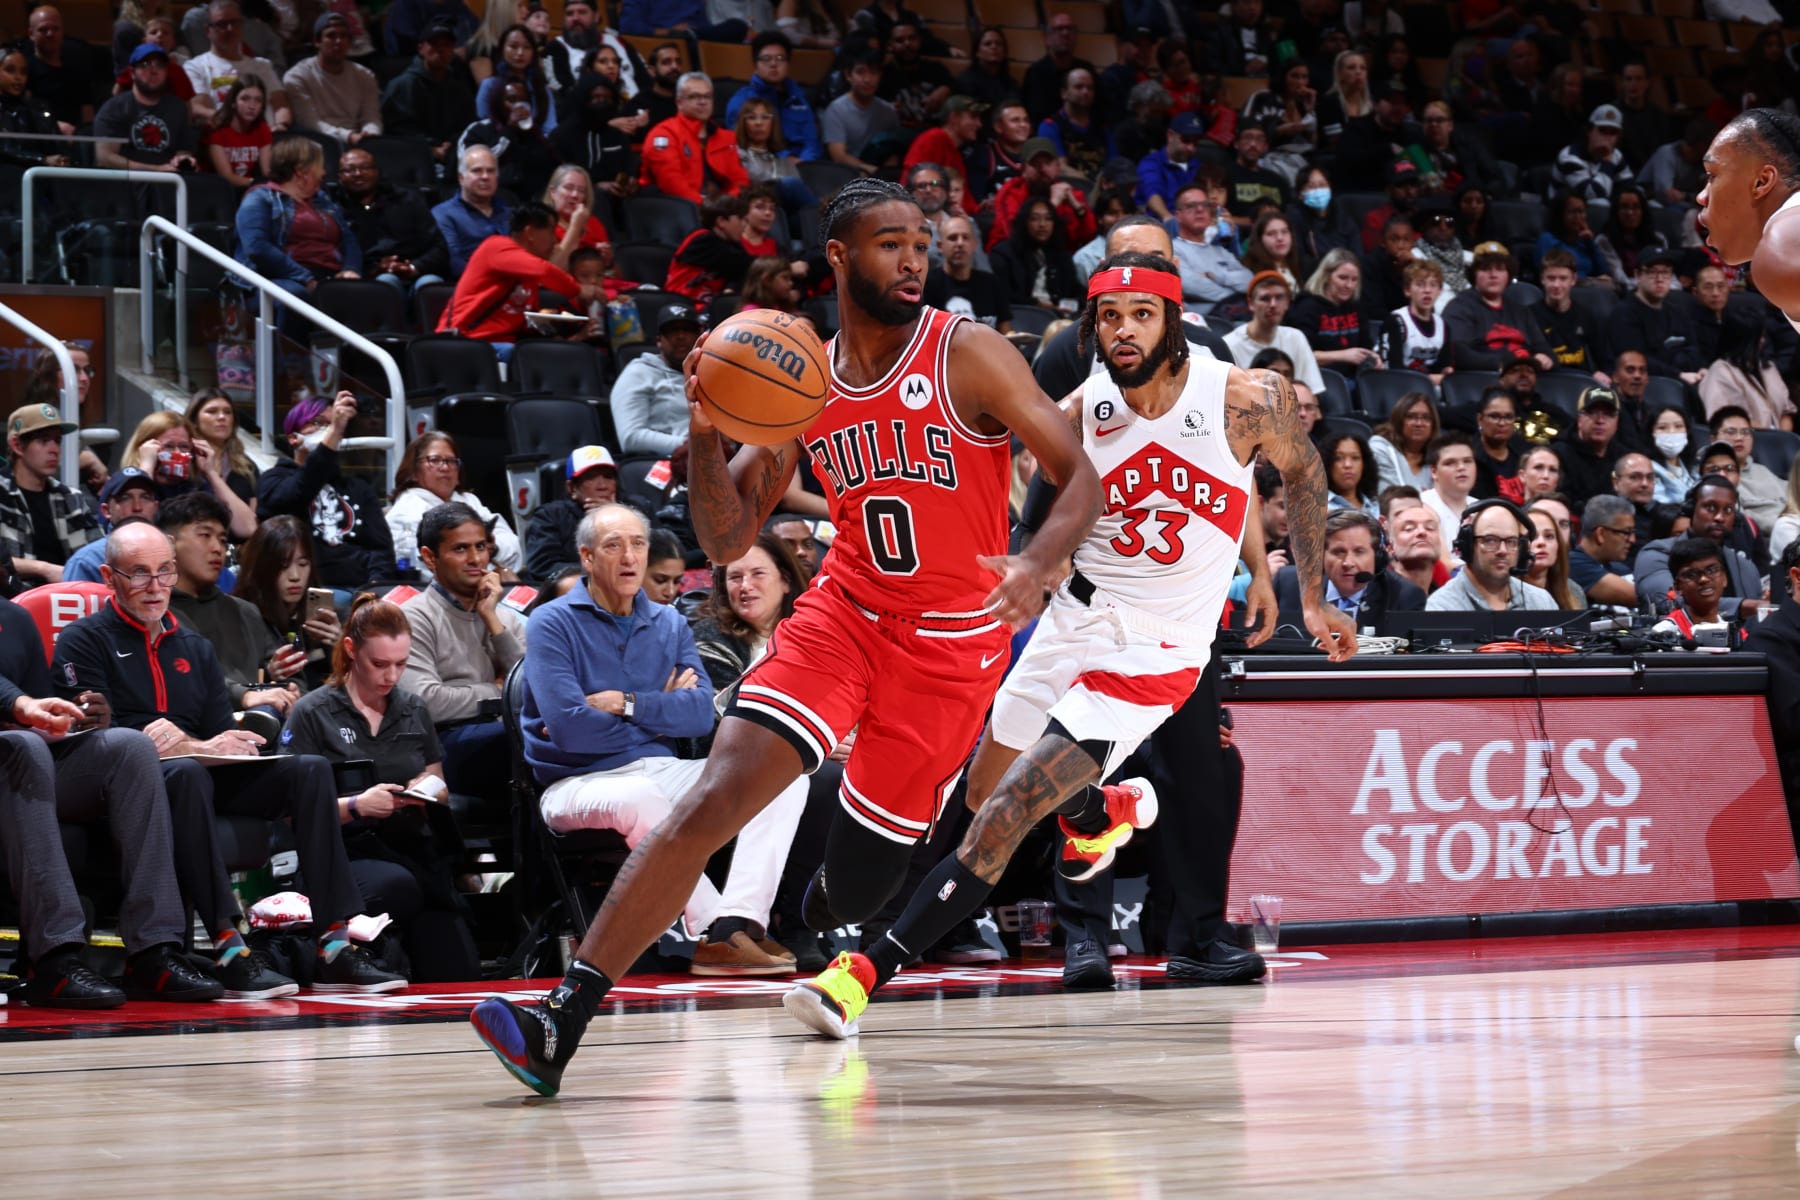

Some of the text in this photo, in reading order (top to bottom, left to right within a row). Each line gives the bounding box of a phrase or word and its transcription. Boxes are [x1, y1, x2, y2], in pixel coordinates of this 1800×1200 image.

[723, 325, 806, 383] Wilson
[807, 419, 959, 499] BULLS
[1196, 429, 1211, 437] Life
[1104, 457, 1228, 514] APTORS
[862, 496, 921, 577] 0
[1110, 508, 1189, 565] 33
[1360, 816, 1654, 885] STORAGE
